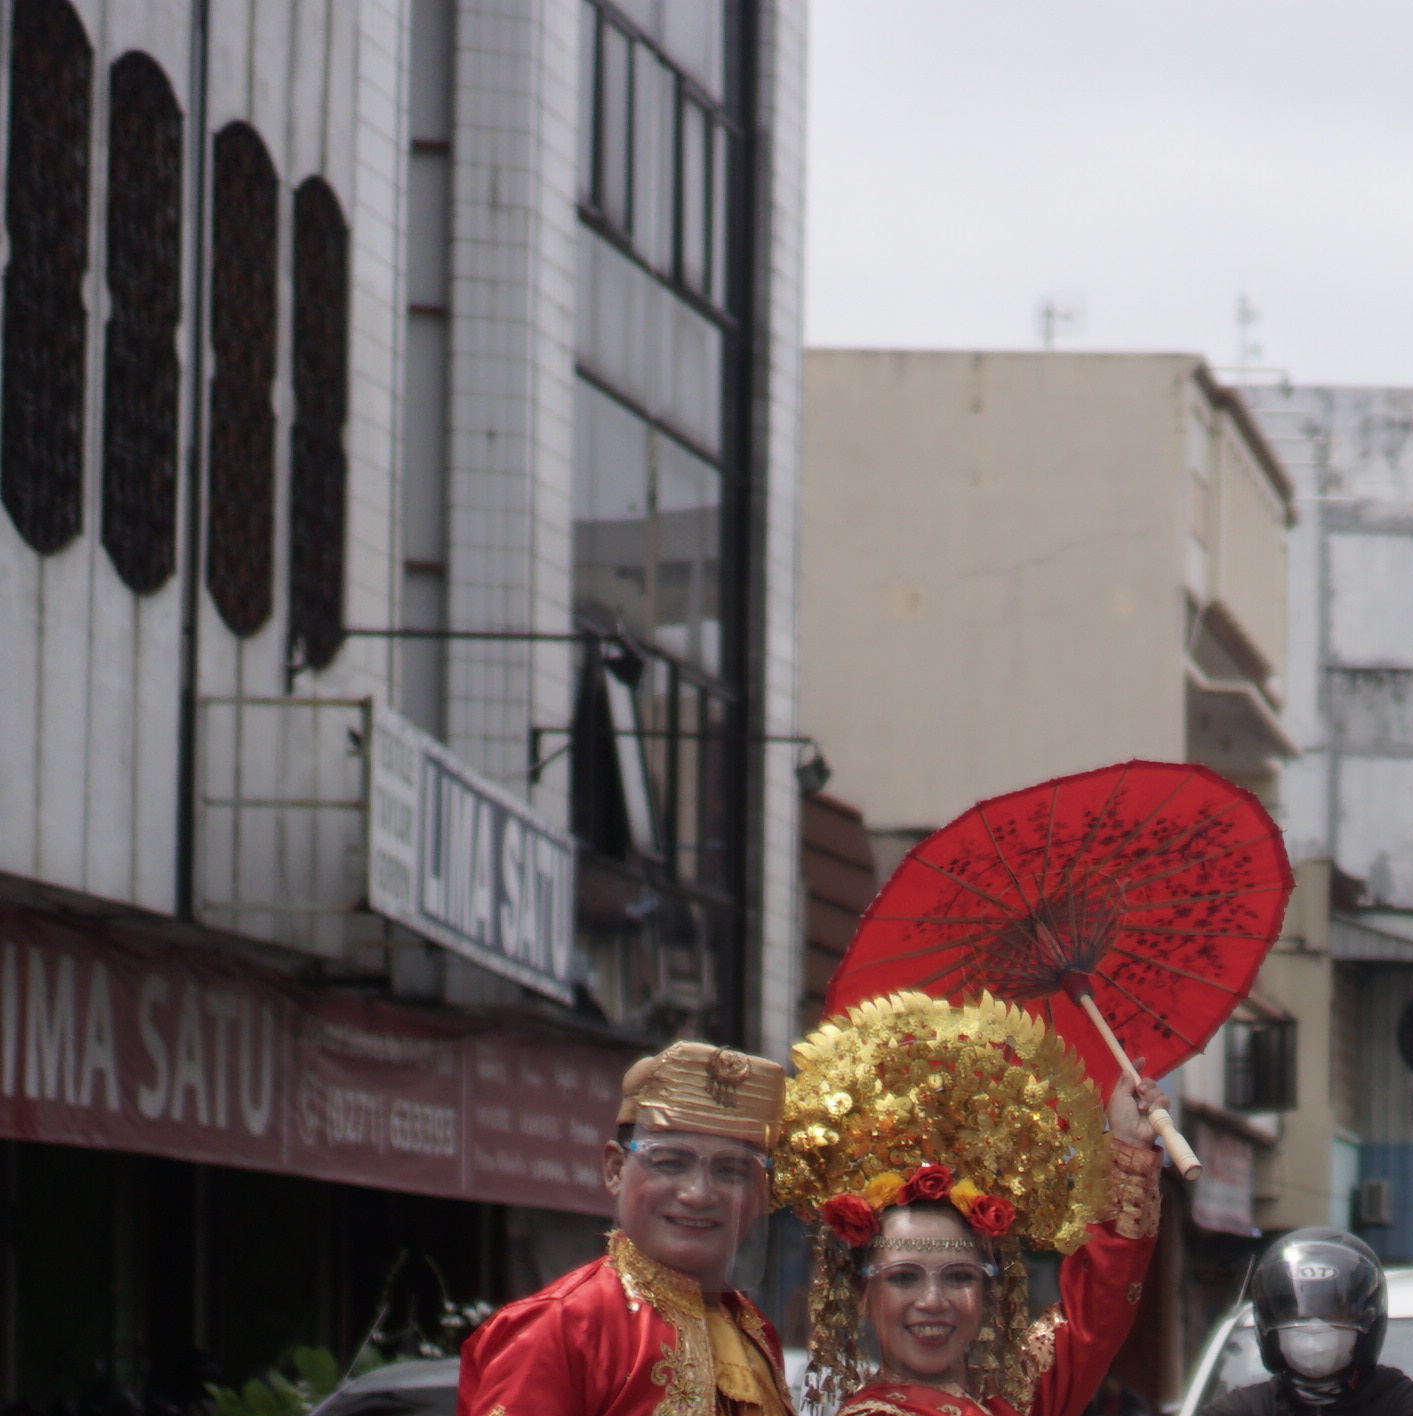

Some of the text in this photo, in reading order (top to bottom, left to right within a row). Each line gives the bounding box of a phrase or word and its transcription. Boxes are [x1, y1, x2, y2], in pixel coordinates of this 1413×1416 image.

[423, 756, 573, 981] LIMA SATU
[138, 971, 274, 1138] SATU
